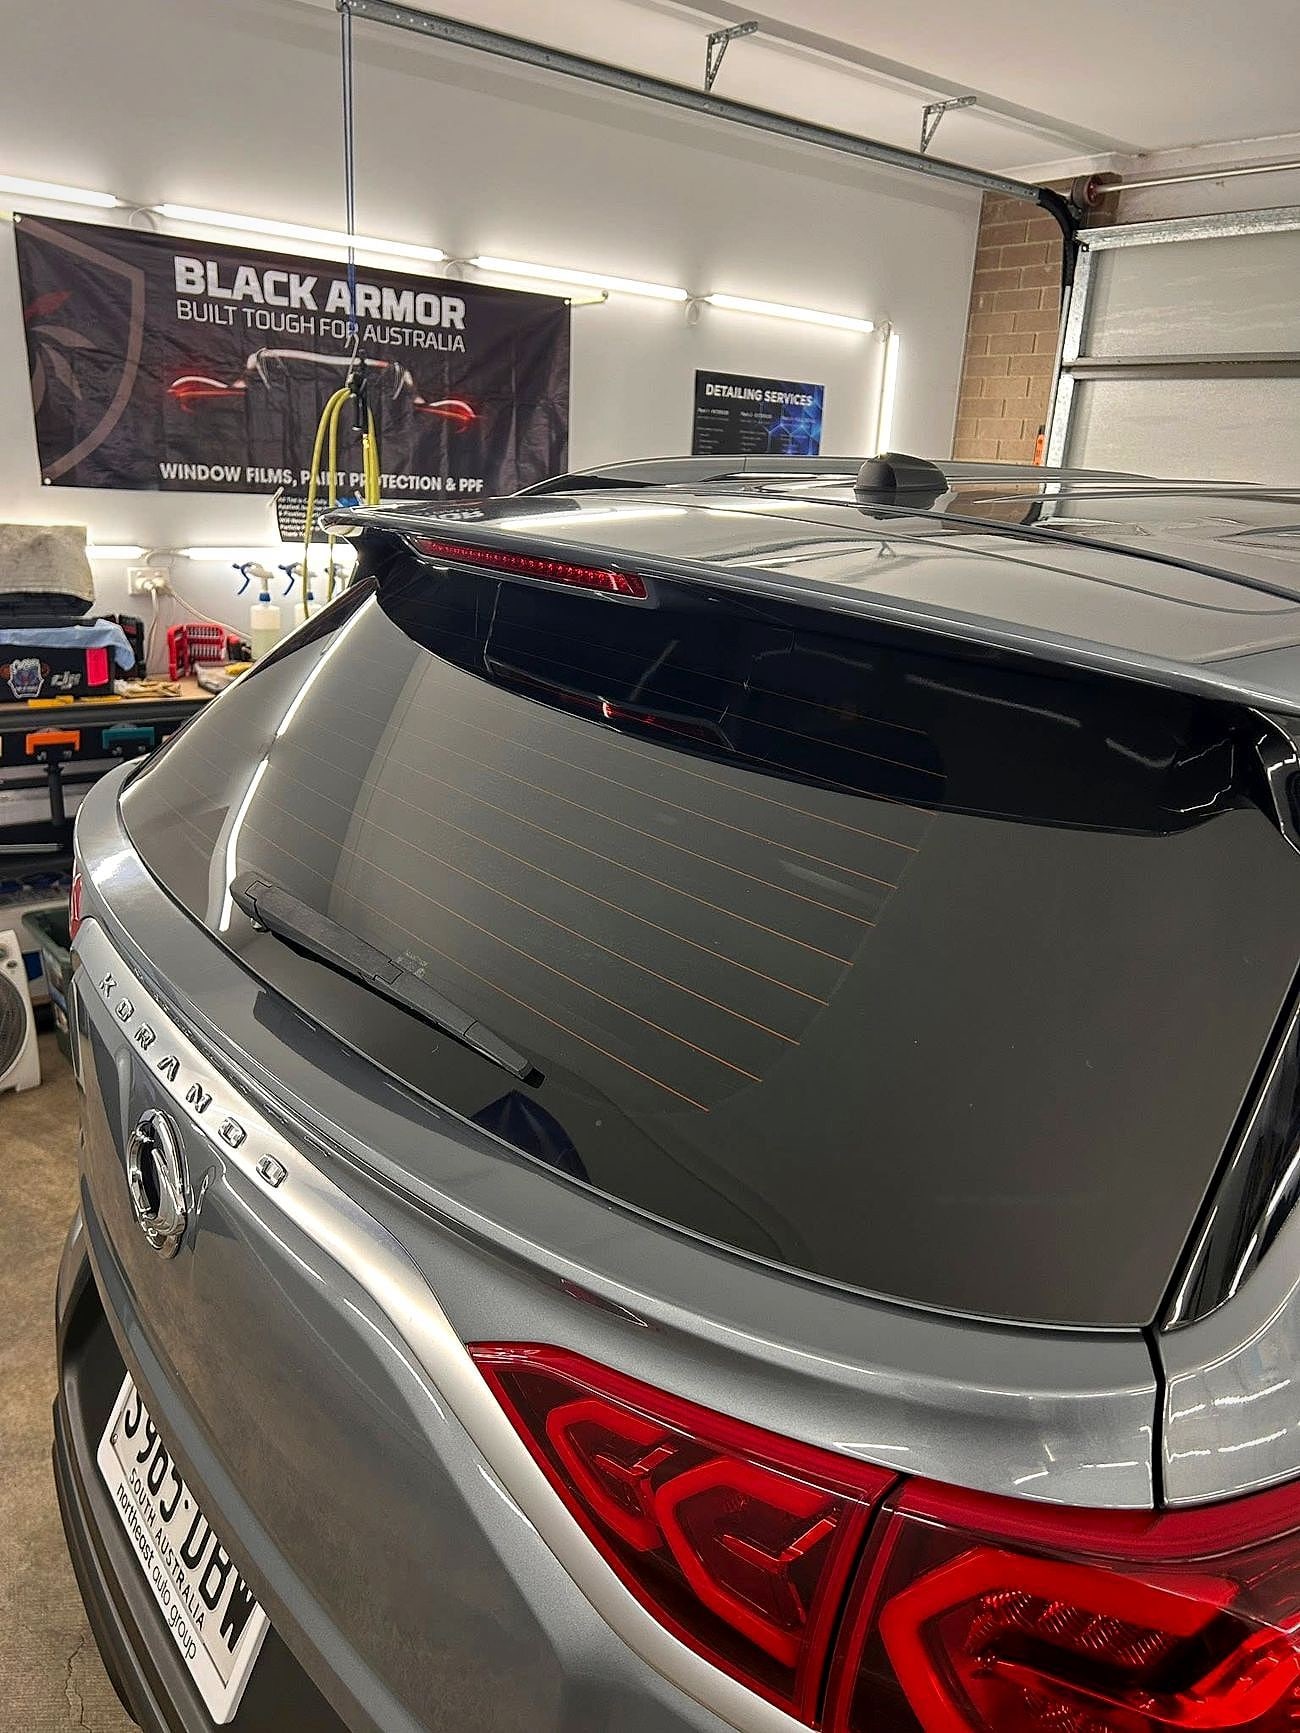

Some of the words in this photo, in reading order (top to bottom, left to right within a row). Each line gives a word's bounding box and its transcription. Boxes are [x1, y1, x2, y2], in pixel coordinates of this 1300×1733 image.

[174, 256, 318, 310] BLACK
[325, 280, 466, 330] ARMOR
[177, 299, 237, 325] BUILT
[242, 307, 315, 335] TOUGH
[320, 318, 358, 340] FOR
[363, 323, 466, 352] AUSTRALIA
[705, 384, 762, 401] DETAILING
[764, 390, 813, 406] SERVICES
[159, 463, 241, 482] WINDOW
[246, 467, 298, 487] FILMS,
[350, 472, 442, 491] PTECTION
[445, 477, 456, 492] &
[459, 478, 483, 492] PPF
[99, 972, 288, 1188] KORANDO
[117, 1482, 155, 1569] northeast
[152, 1566, 171, 1606] auto
[168, 1604, 197, 1660] group
[129, 1467, 156, 1527] SOUTH
[155, 1527, 206, 1631] AUSTRALIA
